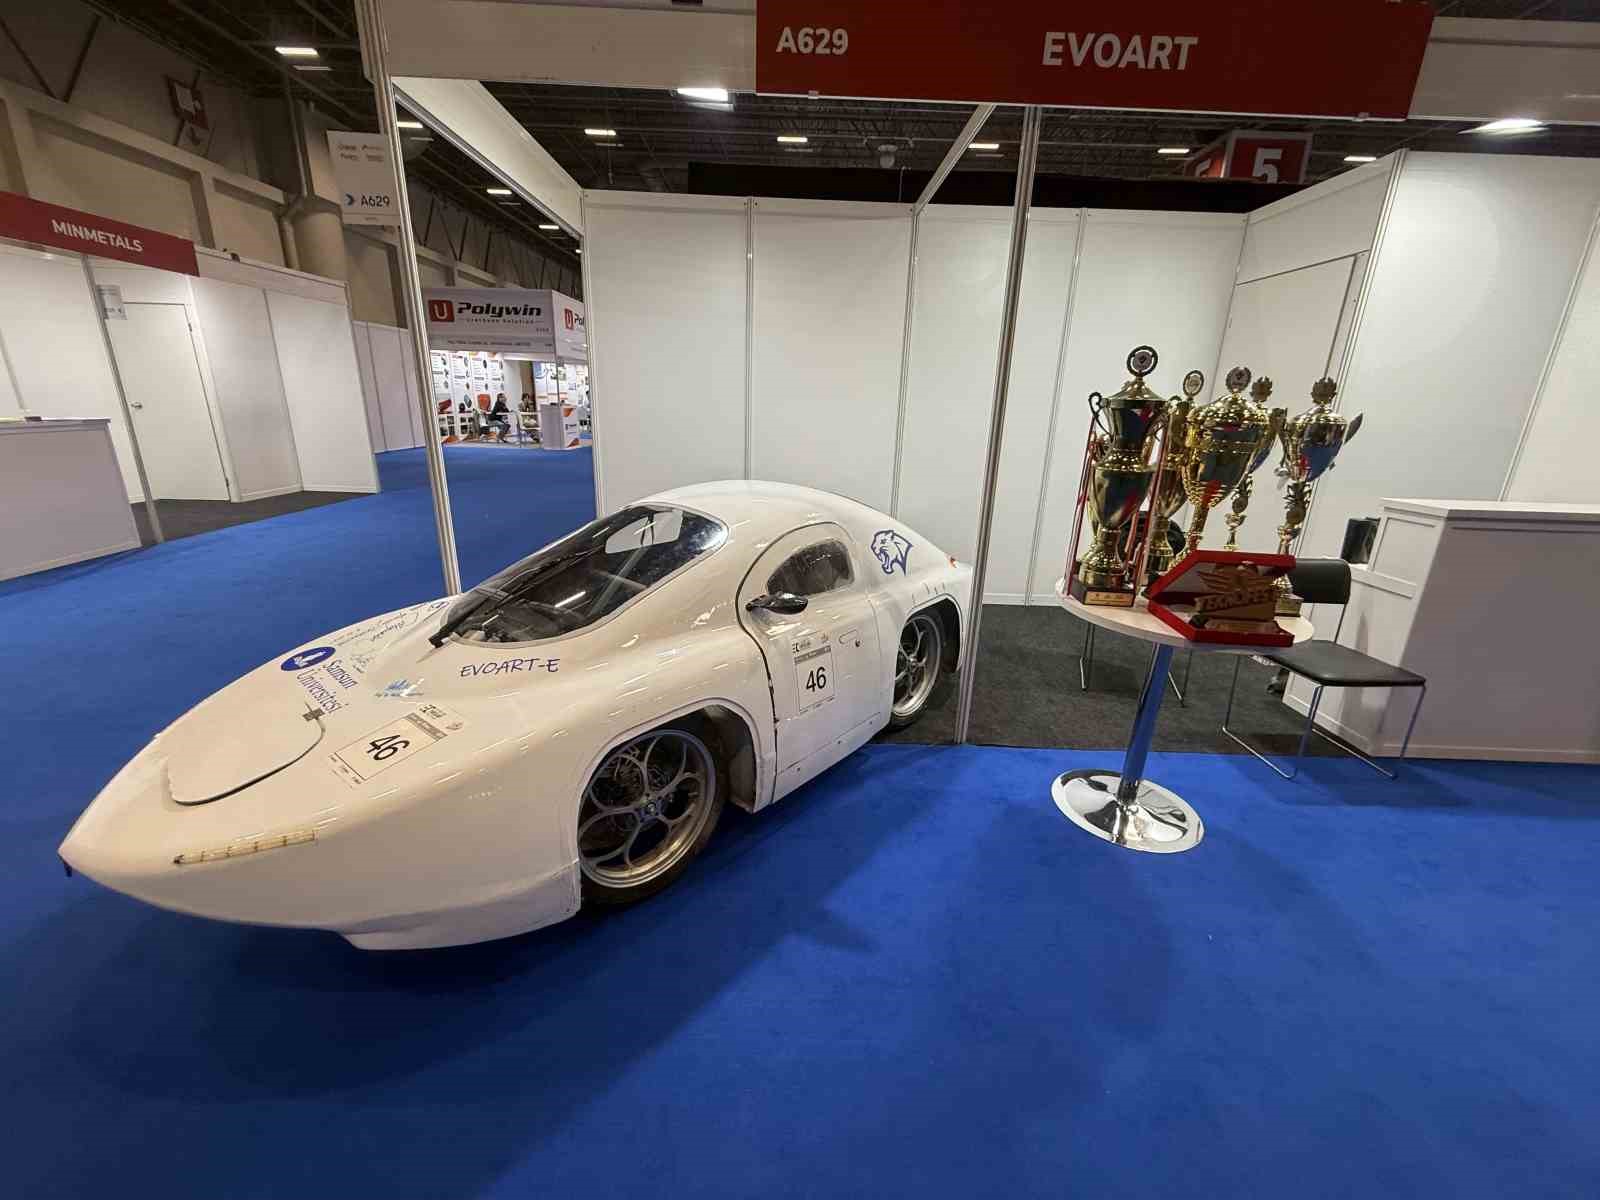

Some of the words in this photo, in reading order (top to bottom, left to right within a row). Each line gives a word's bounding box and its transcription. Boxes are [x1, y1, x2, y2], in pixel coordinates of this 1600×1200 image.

[776, 27, 848, 55] A629
[1042, 31, 1198, 71] EVOART
[1252, 147, 1283, 184] 5
[361, 195, 391, 208] A629
[51, 219, 144, 253] MINMETALS
[457, 302, 542, 318] Polywin
[324, 659, 359, 690] Samsun
[460, 658, 561, 678] EVOART-E
[806, 666, 827, 693] 46
[366, 734, 411, 762] 46
